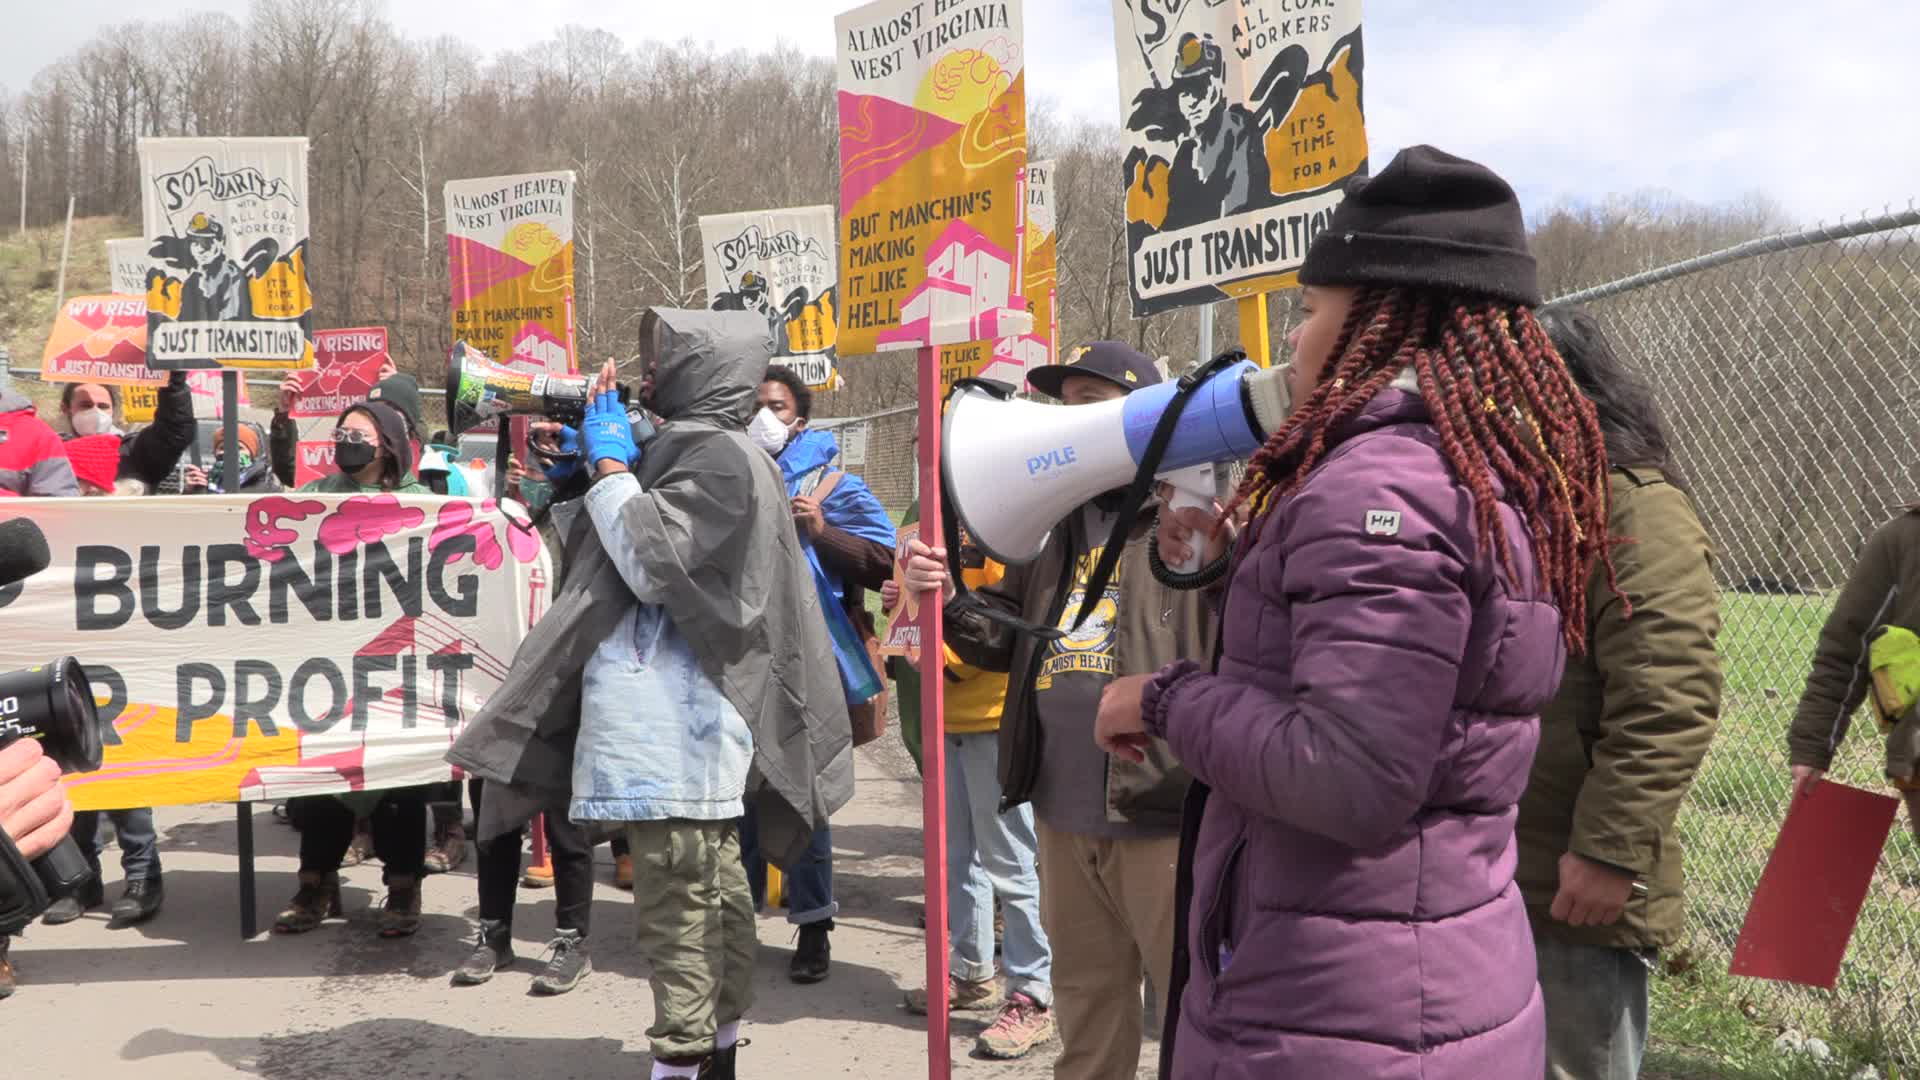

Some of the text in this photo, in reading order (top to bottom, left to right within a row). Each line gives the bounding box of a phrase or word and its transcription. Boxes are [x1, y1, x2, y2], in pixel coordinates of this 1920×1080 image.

[848, 2, 924, 52] ALMOST
[1231, 9, 1270, 42] ALL
[1236, 14, 1331, 60] WORKERS
[850, 4, 1009, 81] WEST VIRGINIA
[1291, 114, 1326, 137] IT'S
[1291, 130, 1335, 157] TIME
[1293, 158, 1338, 181] FOR A
[166, 164, 279, 211] SOLIDARITY
[453, 178, 567, 210] ALMOST HEAVEN
[230, 210, 296, 225] ALL COAL
[455, 199, 562, 230] WEST VIRGINIA
[850, 213, 880, 242] BUT
[889, 190, 992, 232] MANCHIN'S
[233, 223, 293, 237] WORKERS
[724, 231, 811, 271] SOLIDARITY
[849, 235, 915, 269] MAKING
[1141, 237, 1193, 290] JUST
[849, 267, 907, 299] IT LIKE
[69, 301, 99, 316] WV
[456, 306, 553, 324] BUT MANCHIN'S
[848, 297, 899, 330] HELL
[160, 328, 298, 355] JUST TRANSITION
[326, 335, 383, 352] RISING
[955, 346, 981, 363] LIKE
[61, 359, 92, 377] JUST
[131, 394, 157, 409] HEL
[303, 446, 336, 465] WV
[1026, 446, 1077, 475] PYLE
[1371, 514, 1395, 527] HH
[74, 534, 480, 631] BURNING
[1080, 655, 1111, 671] HEAV
[175, 652, 474, 743] PROFIT
